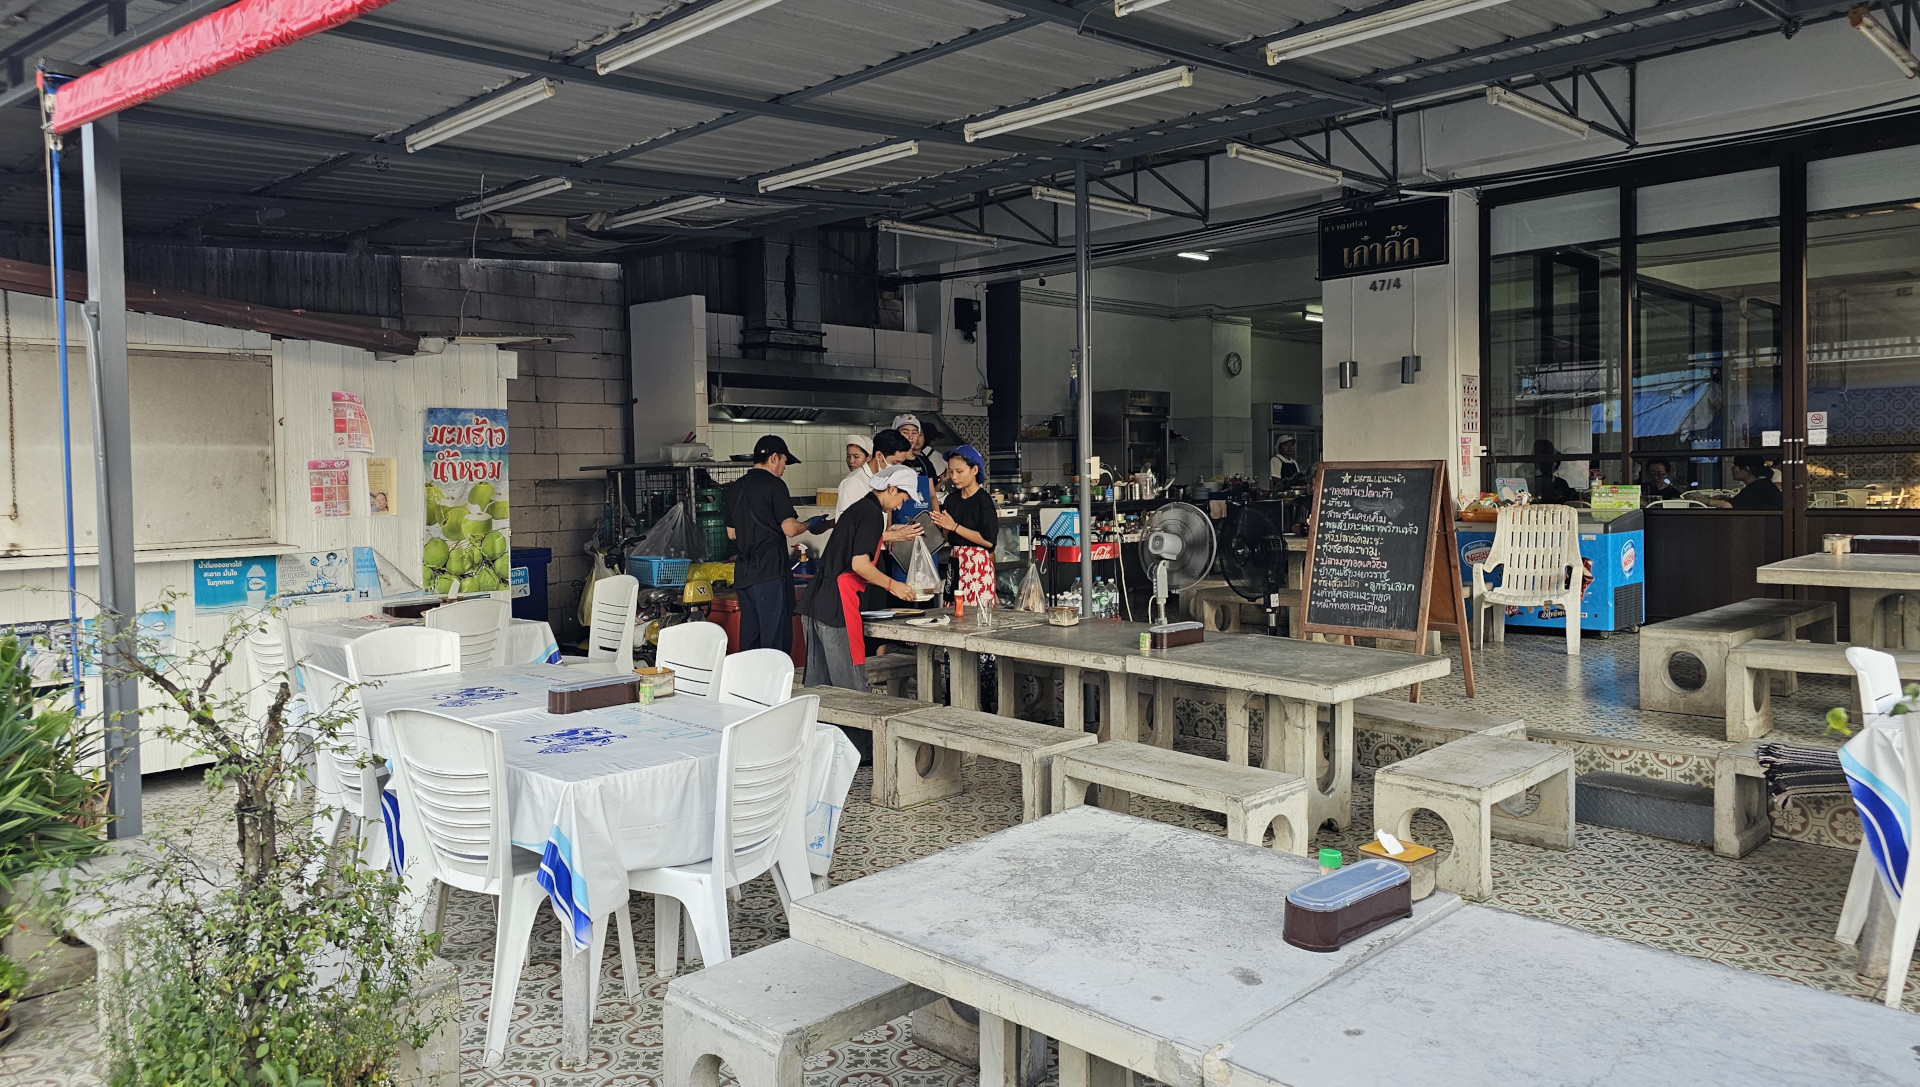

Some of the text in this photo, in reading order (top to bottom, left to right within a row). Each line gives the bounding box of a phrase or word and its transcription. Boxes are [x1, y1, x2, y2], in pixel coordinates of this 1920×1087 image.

[1369, 278, 1402, 292] 47/4
[427, 416, 507, 448] มะพร้าว
[431, 448, 503, 484] น้ำหอม
